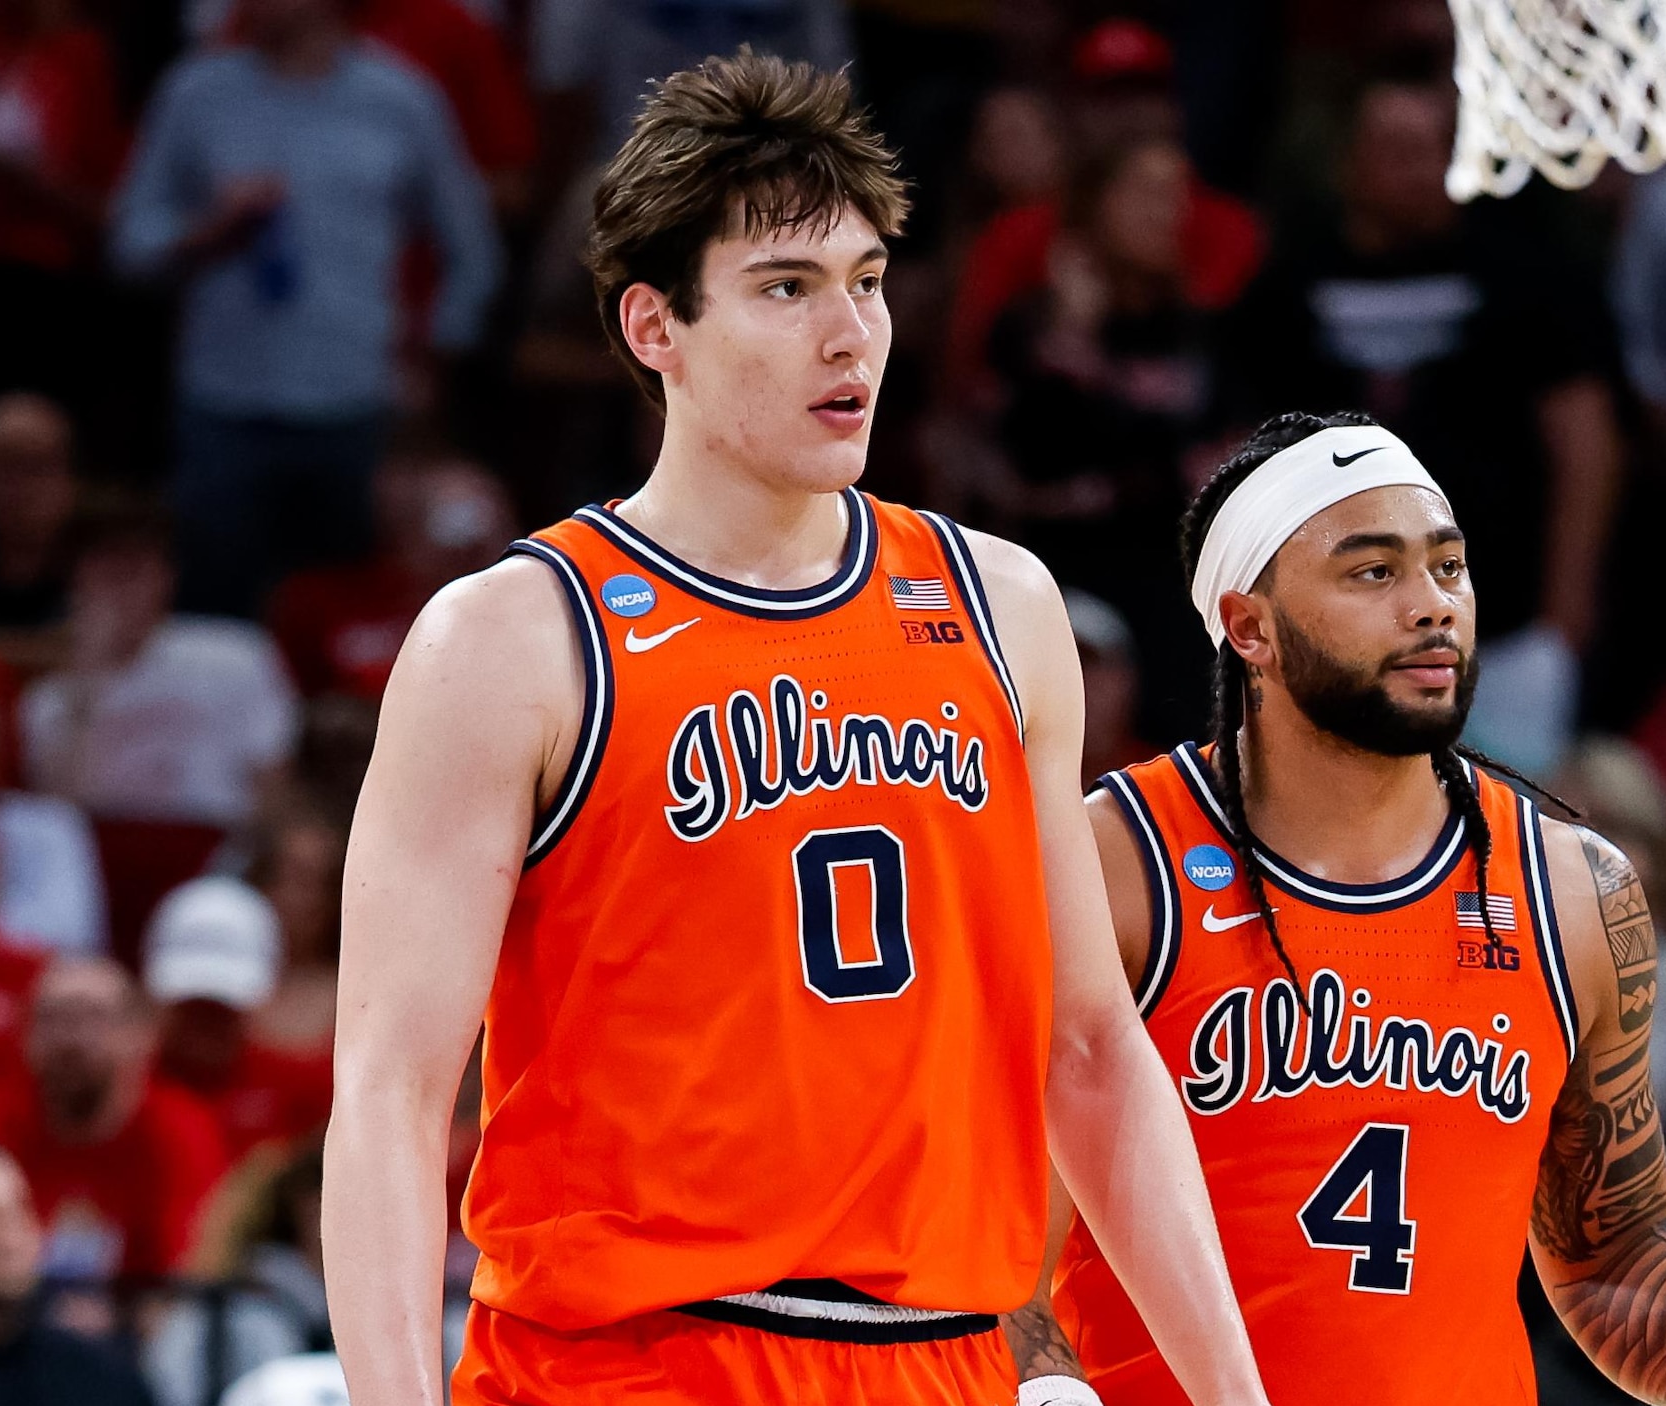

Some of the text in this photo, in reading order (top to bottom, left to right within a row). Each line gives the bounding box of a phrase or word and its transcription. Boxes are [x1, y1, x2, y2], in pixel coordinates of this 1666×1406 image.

[610, 590, 653, 608] NCAA
[664, 673, 989, 843] Illinois
[791, 824, 916, 1004] 0
[1191, 865, 1233, 879] NCAA
[1180, 968, 1531, 1124] Illinois
[1296, 1122, 1417, 1296] 4
